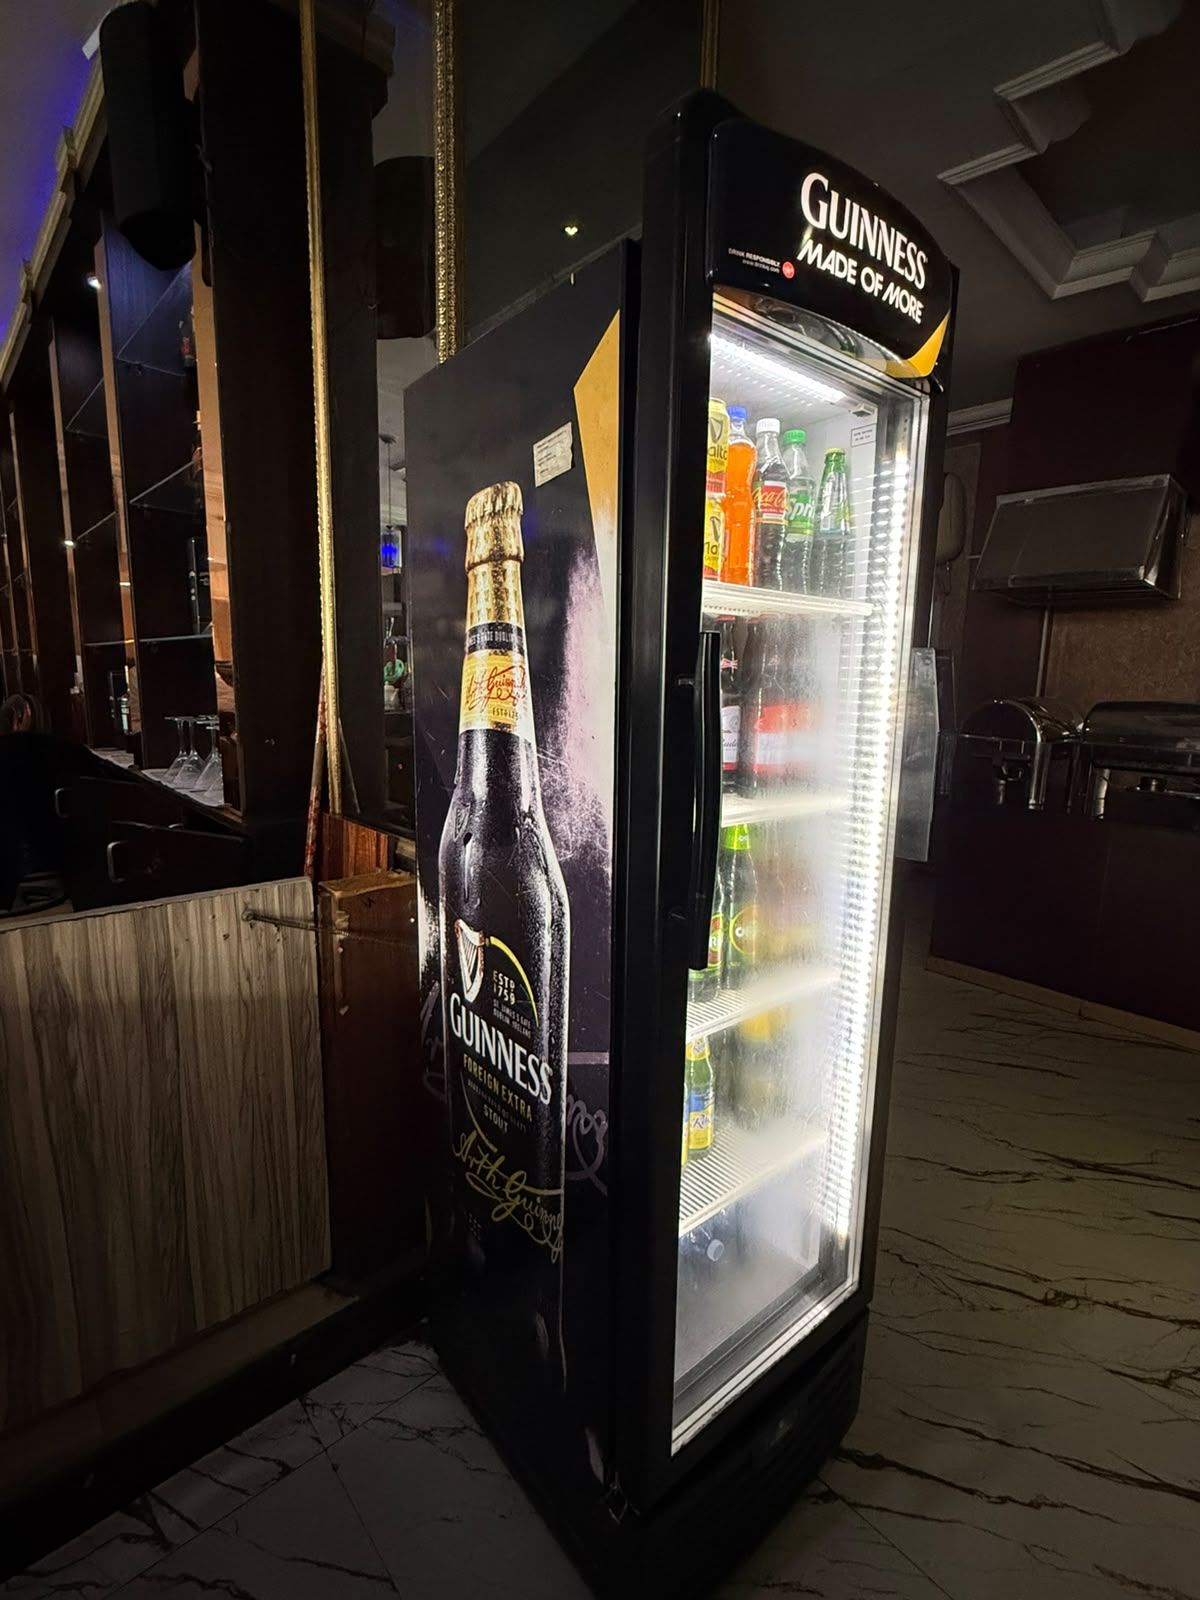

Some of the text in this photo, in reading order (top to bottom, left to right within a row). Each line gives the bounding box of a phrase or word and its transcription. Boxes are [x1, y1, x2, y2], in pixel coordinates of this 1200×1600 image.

[800, 172, 927, 290] GUINNESS
[797, 240, 857, 285] MADE
[860, 268, 883, 297] OF
[881, 282, 924, 324] MORE
[450, 992, 554, 1105] GUINNESS
[463, 1053, 500, 1096] FOREIGN
[501, 1084, 533, 1122] EXTRA
[483, 1103, 508, 1134] STOUT
